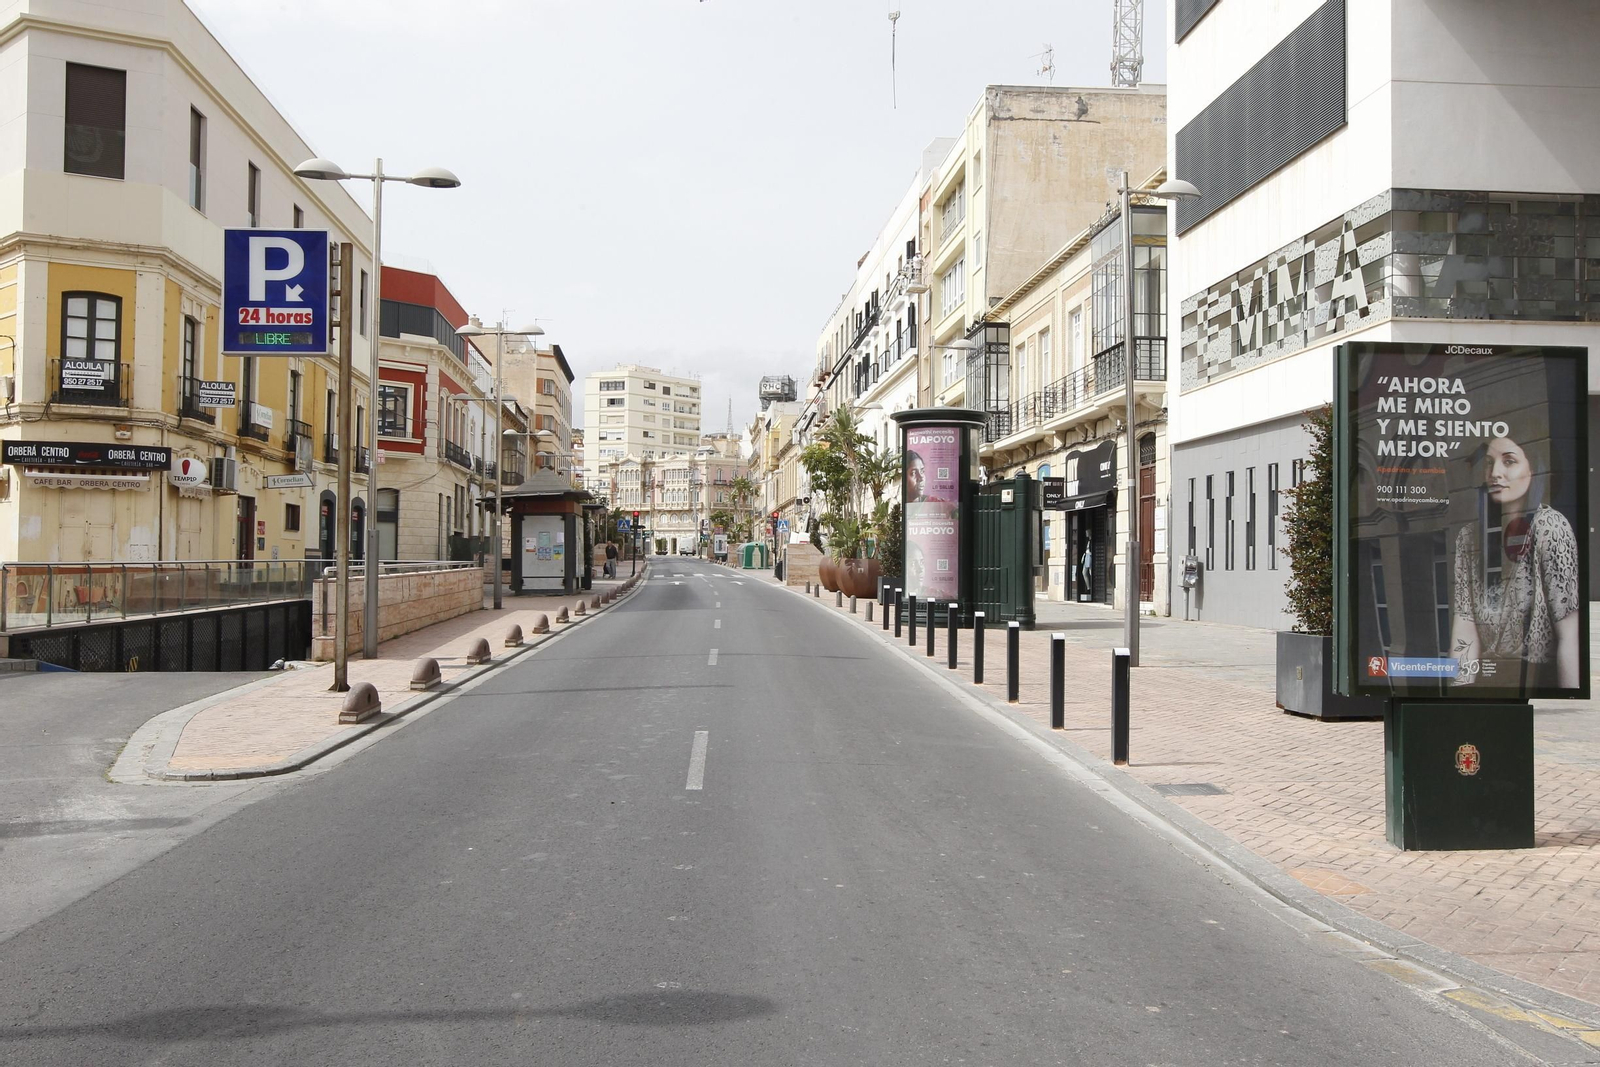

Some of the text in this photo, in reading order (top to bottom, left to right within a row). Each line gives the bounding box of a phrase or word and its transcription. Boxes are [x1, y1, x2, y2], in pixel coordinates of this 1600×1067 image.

[248, 236, 305, 302] P
[239, 307, 313, 324] 24 horas
[255, 332, 292, 345] LIBRE
[1444, 345, 1493, 355] JCDecaux
[64, 361, 103, 370] ALQUILA
[63, 377, 78, 385] 950
[200, 382, 234, 390] ALQUILA
[200, 396, 211, 404] 950
[1377, 397, 1471, 415] ME MIRO
[1376, 418, 1510, 438] Y ME SIENTO
[909, 435, 955, 445] TU APOYO
[8, 444, 37, 457] ORBERÁ
[41, 446, 70, 458] CENTRO
[108, 448, 136, 460] ORBERÁ
[139, 450, 166, 462] CENTRO
[1377, 466, 1411, 474] Apadrina
[1376, 485, 1427, 495] 900 111 300
[1376, 496, 1450, 505] www.apadrinaycambia.org
[909, 527, 955, 535] TU APOYO
[1391, 662, 1456, 672] VicenteFerrer
